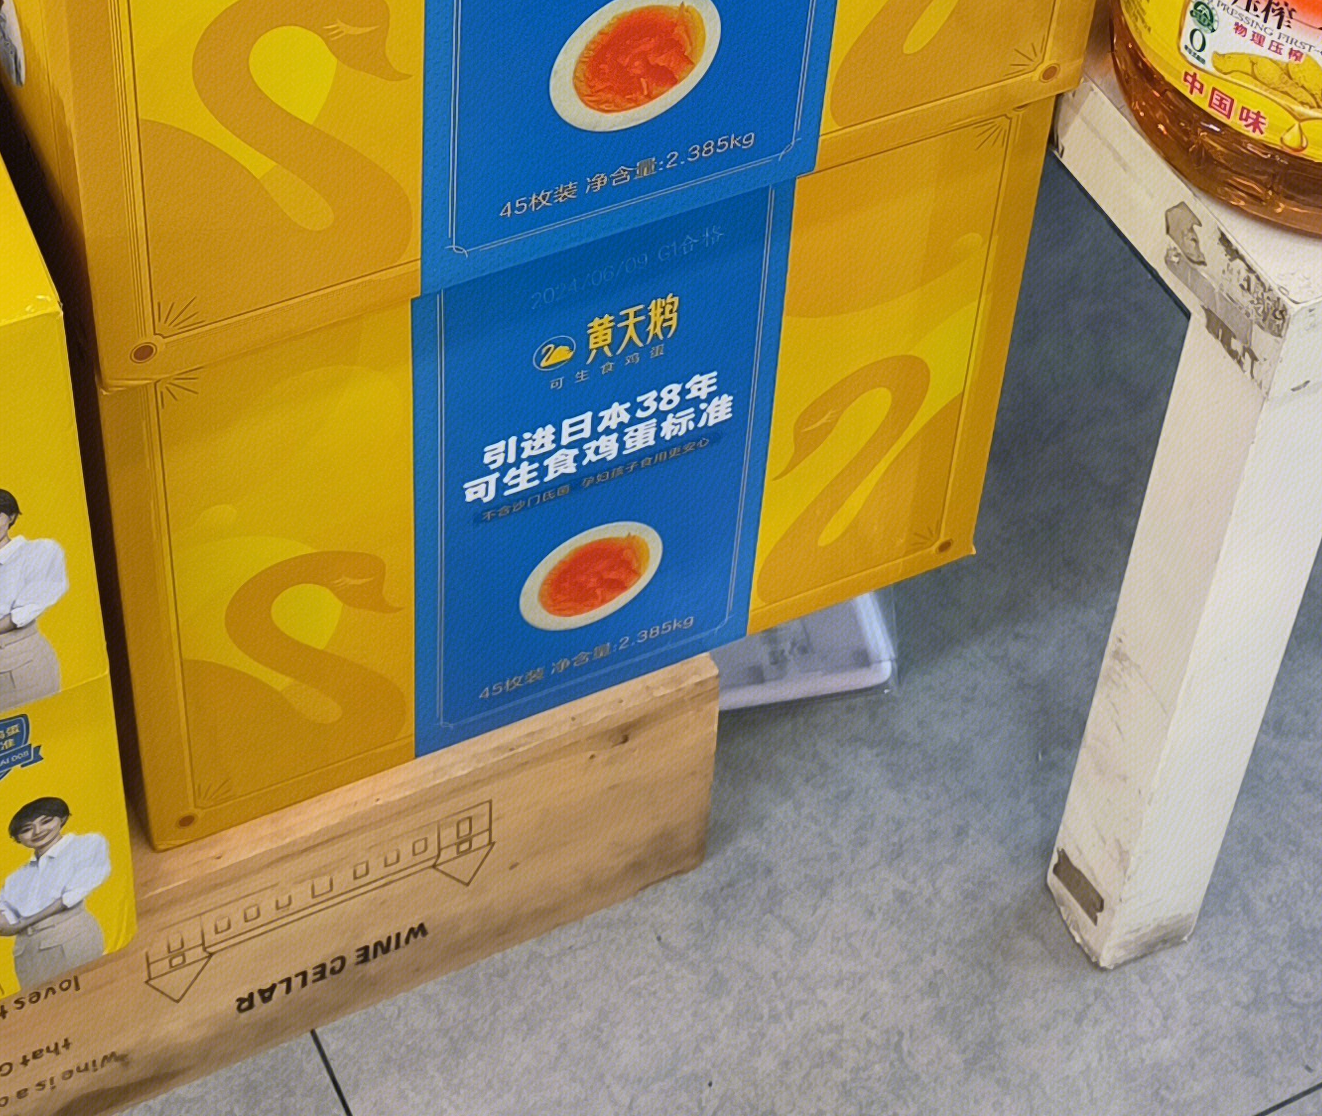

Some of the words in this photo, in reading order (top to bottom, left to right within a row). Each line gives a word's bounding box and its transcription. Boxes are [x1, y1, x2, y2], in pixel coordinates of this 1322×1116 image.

[1232, 21, 1306, 63] 物理压榨
[1181, 70, 1267, 136] 中国味
[498, 178, 578, 219] 45枚装
[585, 129, 756, 195] 净含量:2.385kg
[585, 292, 680, 367] 黄天鹅
[549, 344, 666, 391] 可生食鸡蛋
[481, 370, 720, 470] 引进日本38年
[462, 393, 735, 506] 可生食鸡蛋标准
[479, 663, 545, 700] 45枚装
[550, 614, 696, 677] 净含量:2.385kg
[351, 920, 430, 968] WINE
[13, 975, 81, 1011] loves
[234, 950, 348, 1016] CELLAR
[19, 1037, 73, 1068] that
[15, 1086, 30, 1100] a
[35, 1076, 57, 1091] is
